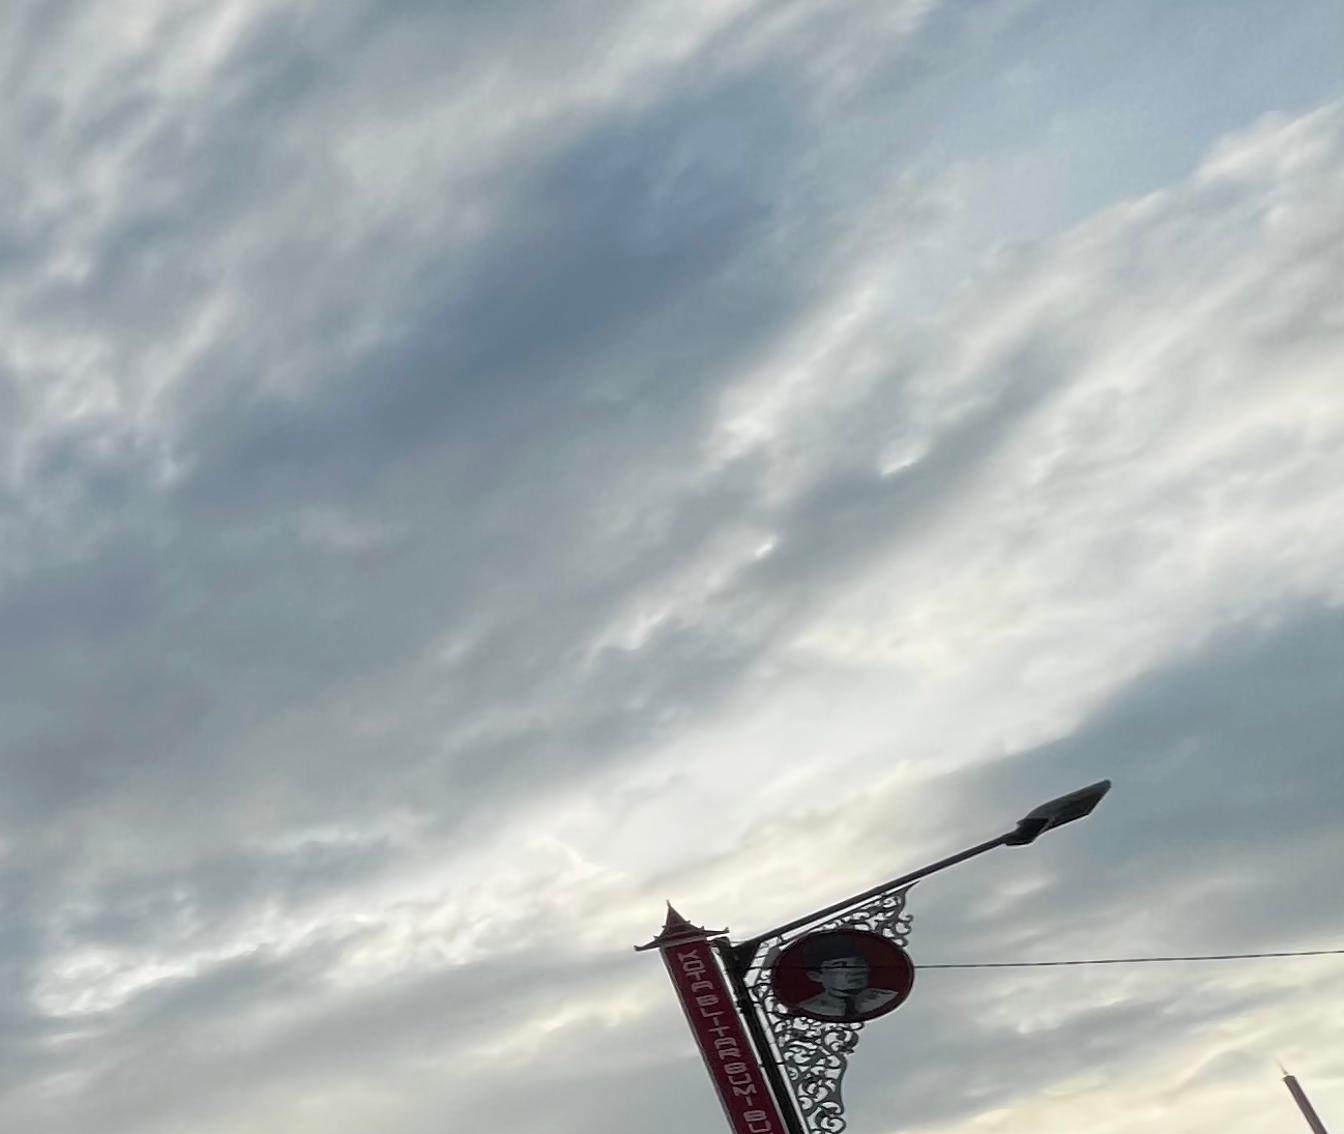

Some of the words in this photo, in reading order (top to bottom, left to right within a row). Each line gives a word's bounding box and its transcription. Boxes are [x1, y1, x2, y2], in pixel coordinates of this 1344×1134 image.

[678, 949, 713, 993] KOTA
[695, 994, 742, 1060] BLITAR
[723, 1061, 758, 1106] BUMI
